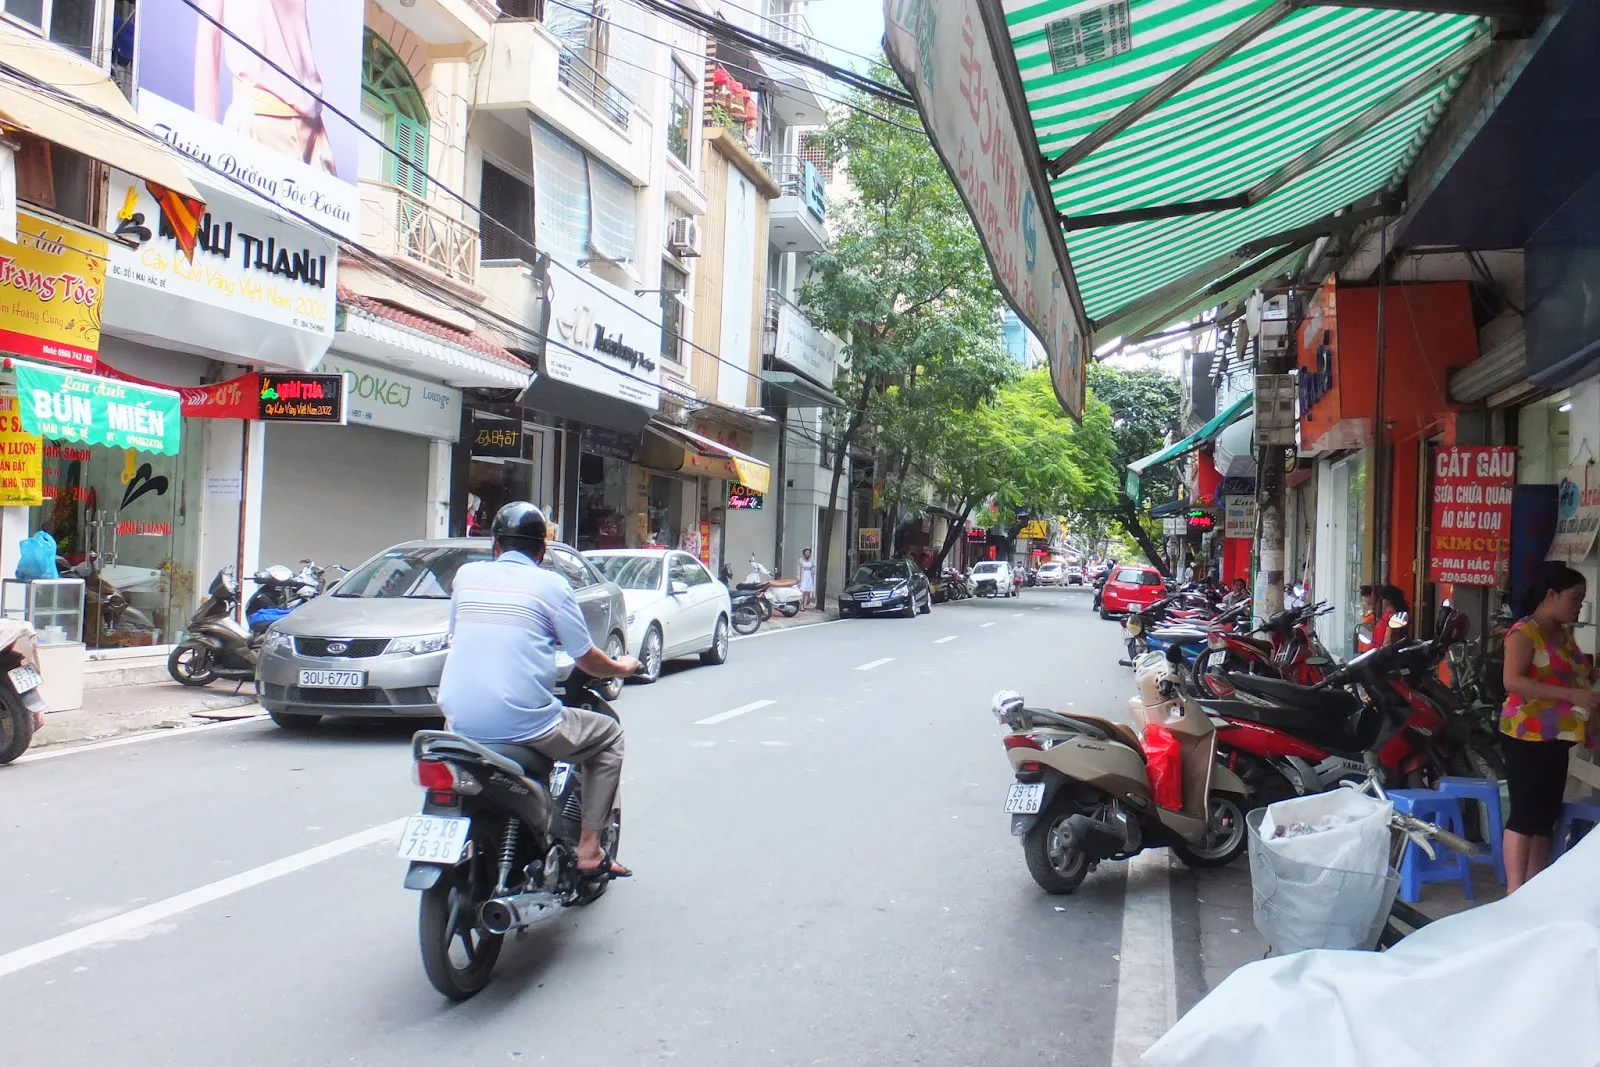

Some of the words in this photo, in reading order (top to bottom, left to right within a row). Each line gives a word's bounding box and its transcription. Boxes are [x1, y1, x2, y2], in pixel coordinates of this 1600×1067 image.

[218, 153, 278, 196] Đường
[281, 178, 307, 206] Tóc
[238, 232, 326, 289] THANH
[61, 274, 96, 307] Tóc
[267, 285, 292, 310] Nam
[295, 297, 327, 320] 2002
[422, 387, 450, 410] Lounge
[32, 389, 92, 426] BÚN
[107, 400, 165, 437] MIẾN
[1436, 446, 1471, 477] CẮT
[1476, 446, 1514, 478] GẤU
[1434, 478, 1453, 504] SỬA
[1456, 481, 1482, 504] CHỮA
[1441, 506, 1455, 528] ÁO
[1456, 506, 1476, 530] CÁC
[302, 671, 359, 686] 30U-6770
[1012, 784, 1039, 799] 29-C1
[1006, 798, 1038, 812] 274.66
[411, 819, 460, 839] 29-X8
[405, 838, 453, 860] 7636
